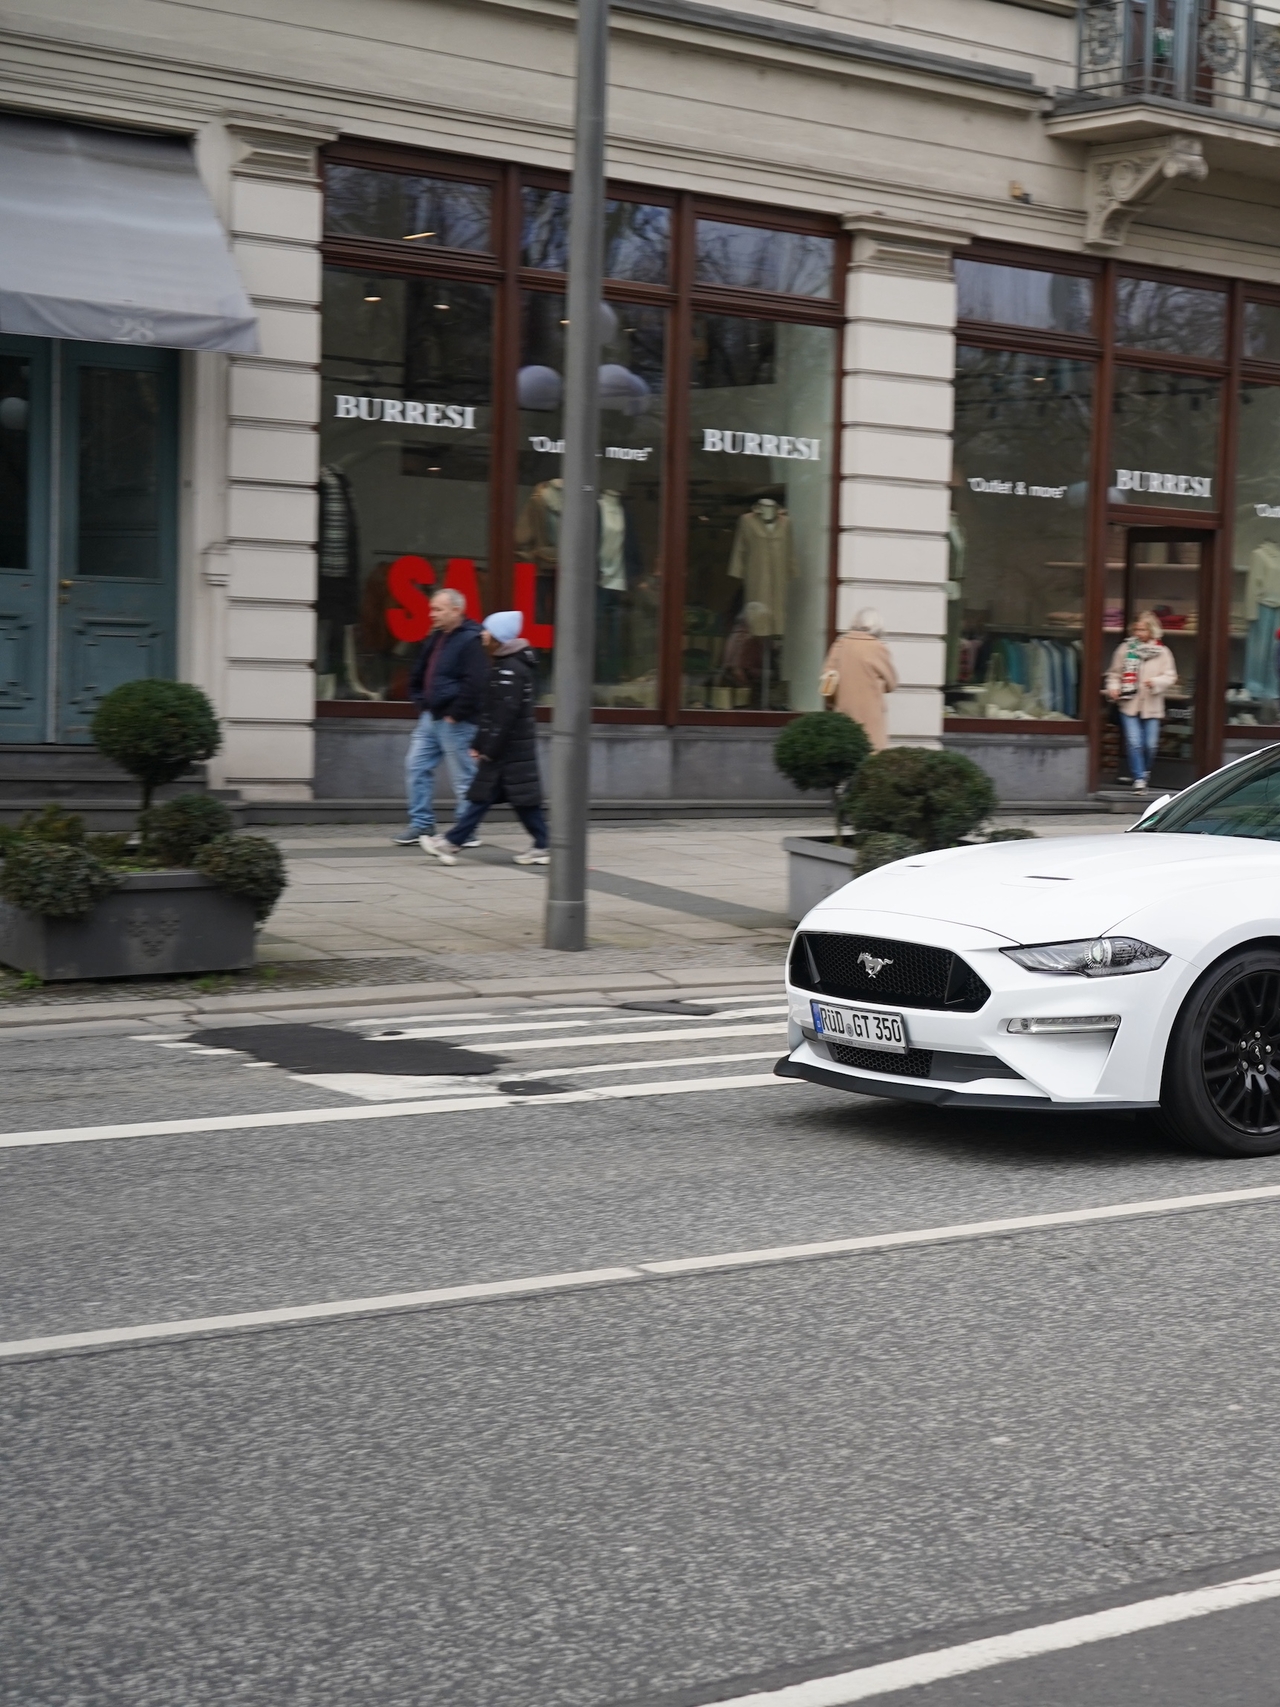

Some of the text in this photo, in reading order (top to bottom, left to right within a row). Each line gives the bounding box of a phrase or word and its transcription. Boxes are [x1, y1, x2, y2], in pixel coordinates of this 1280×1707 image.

[334, 395, 477, 429] BURRESI
[701, 429, 821, 460] BURRESI
[1115, 469, 1212, 498] BURRESI
[385, 555, 555, 649] SAL
[852, 1013, 870, 1039] GT
[873, 1016, 902, 1042] 350
